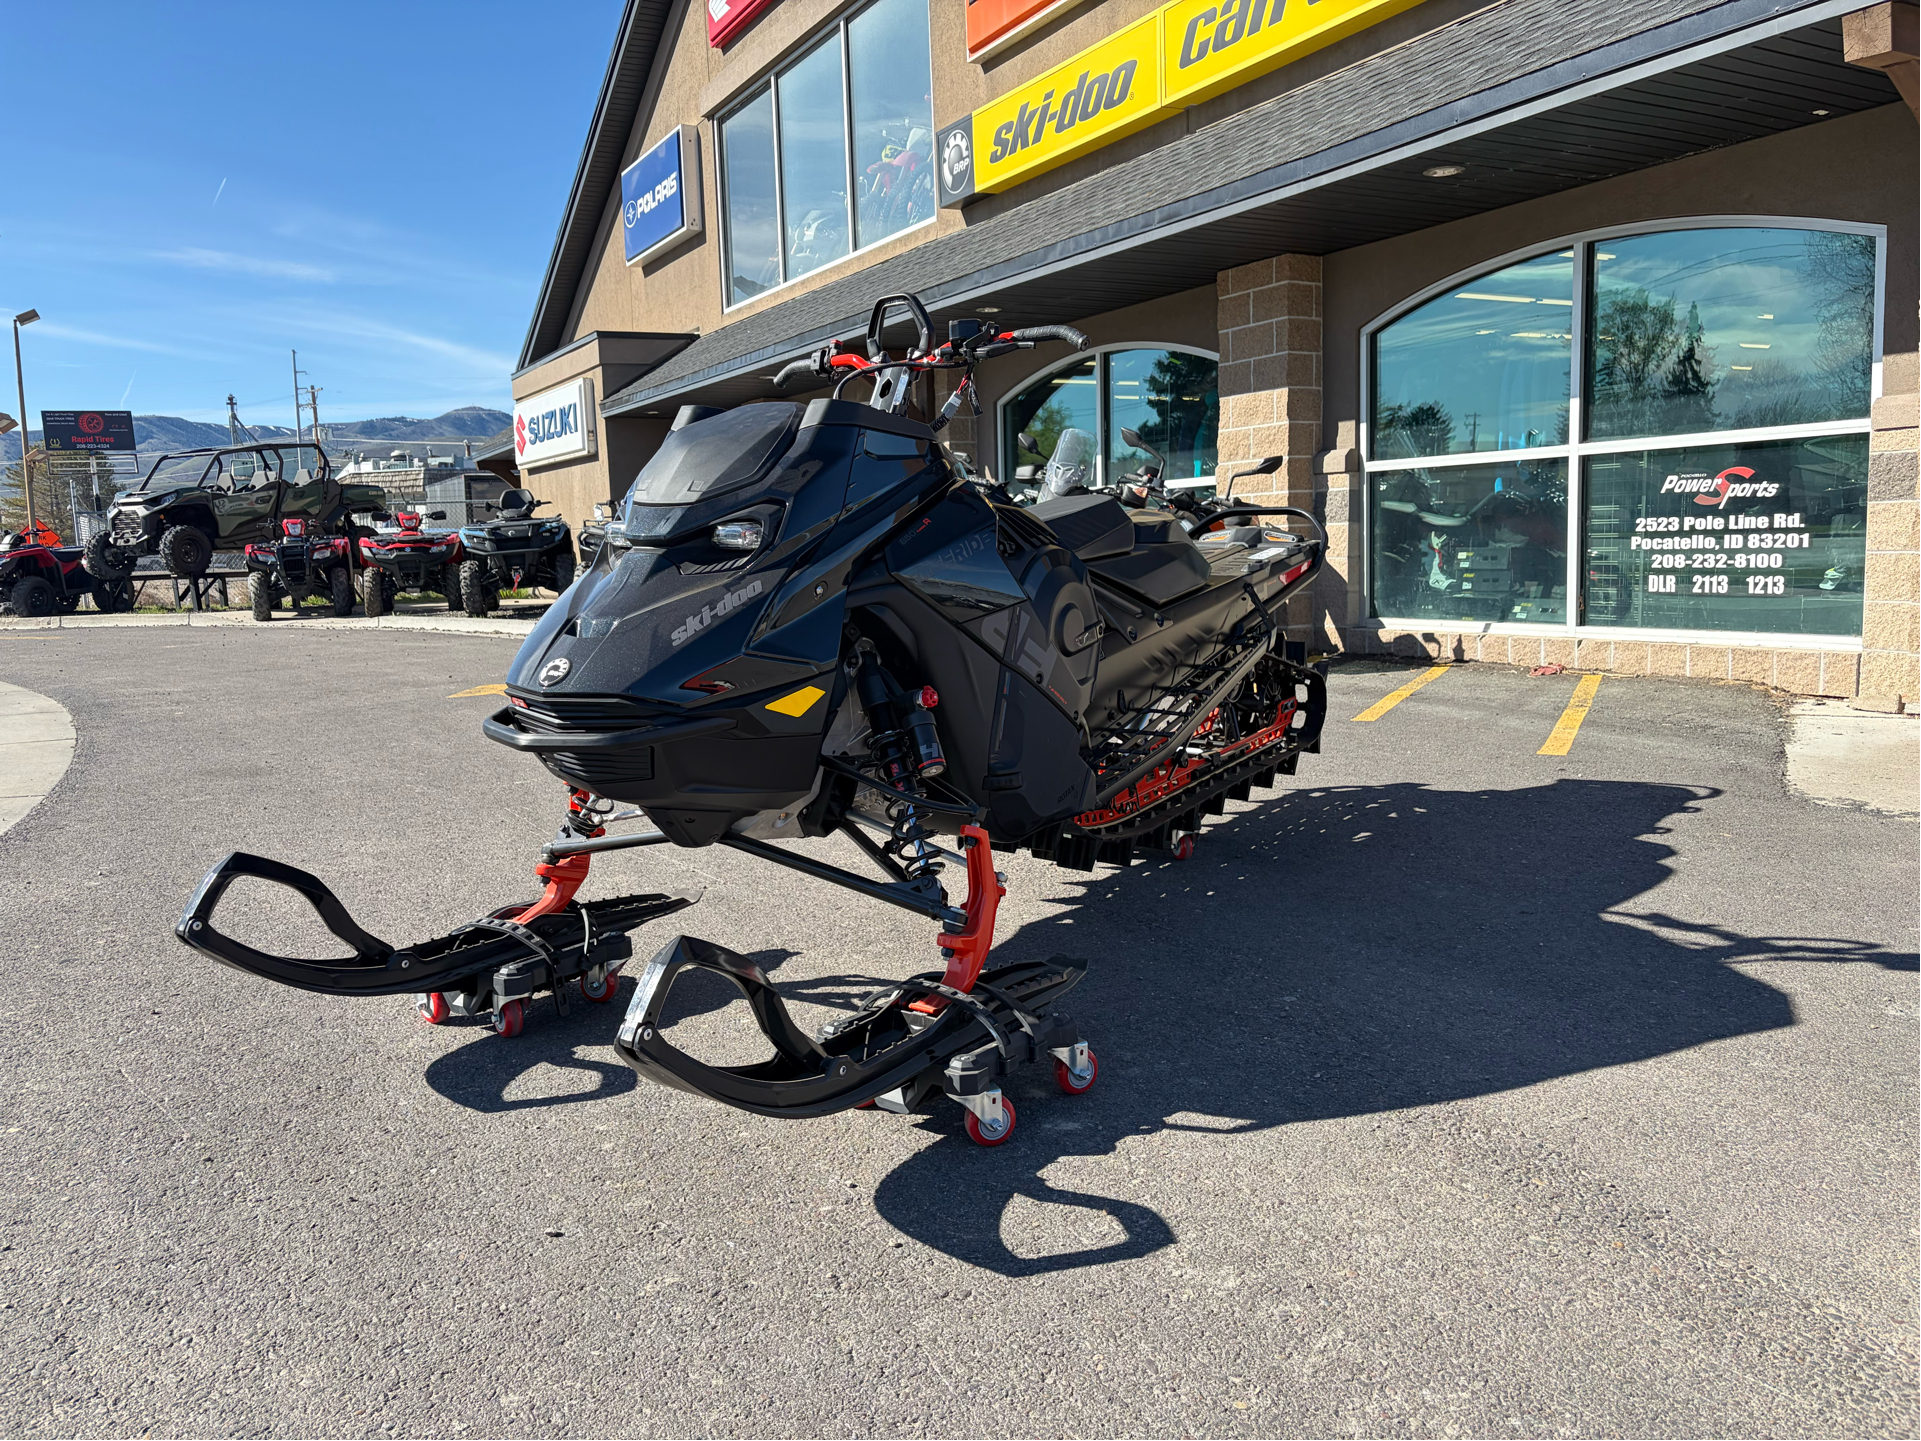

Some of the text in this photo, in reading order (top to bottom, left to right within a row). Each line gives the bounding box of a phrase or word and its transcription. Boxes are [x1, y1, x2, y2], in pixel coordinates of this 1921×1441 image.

[1179, 0, 1321, 69] can
[989, 59, 1138, 165] ski-doo
[953, 157, 970, 175] BRP
[637, 171, 678, 219] POLARIS
[528, 402, 578, 446] SUZUKI
[1635, 513, 1805, 532] 2523 Pole Line Rd.
[900, 529, 917, 546] 850
[1630, 533, 1810, 551] Pocatello, ID 83201
[1651, 553, 1783, 569] 208-232-8100
[1648, 575, 1785, 595] DLR 2113 1213
[671, 580, 763, 647] ski-doo
[1057, 783, 1075, 805] ROTAX
